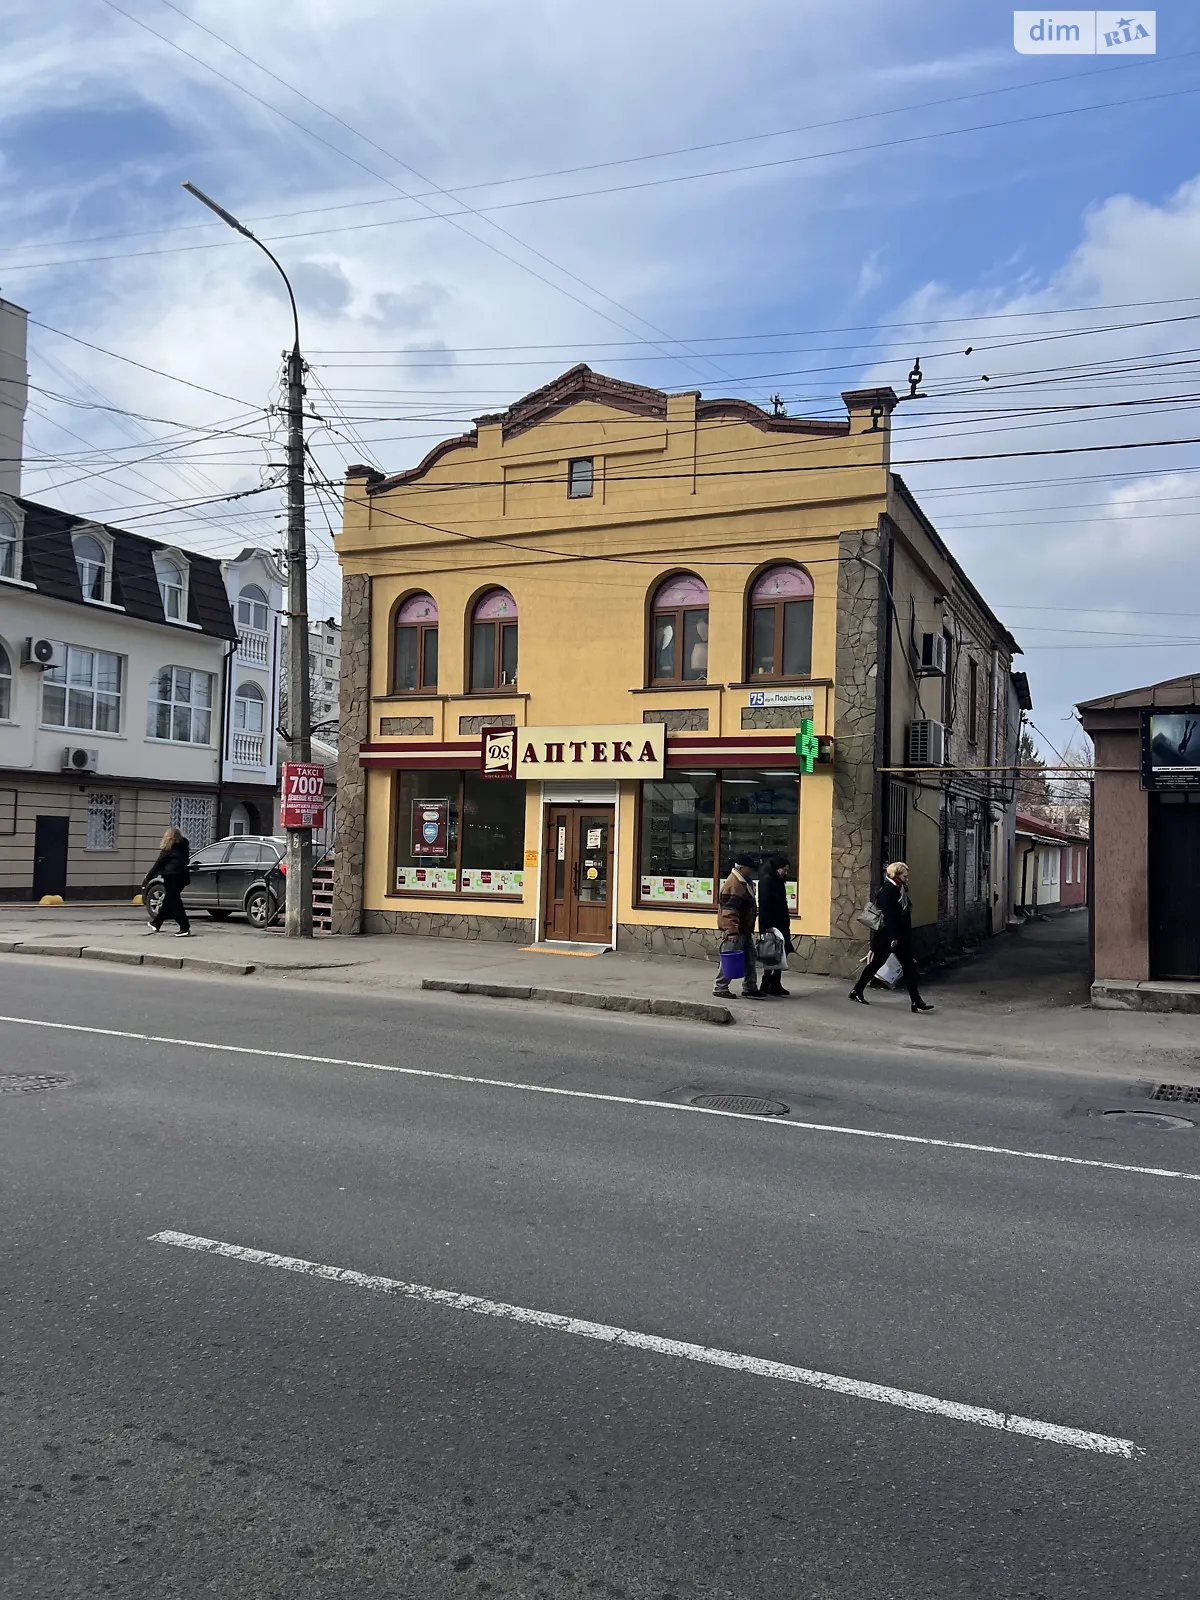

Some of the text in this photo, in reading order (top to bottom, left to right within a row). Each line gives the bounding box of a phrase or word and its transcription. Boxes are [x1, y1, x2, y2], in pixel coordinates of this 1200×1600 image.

[751, 693, 764, 704] 75
[775, 694, 812, 702] Подільська
[521, 740, 658, 763] АПТЕКА
[290, 776, 324, 794] 7007
